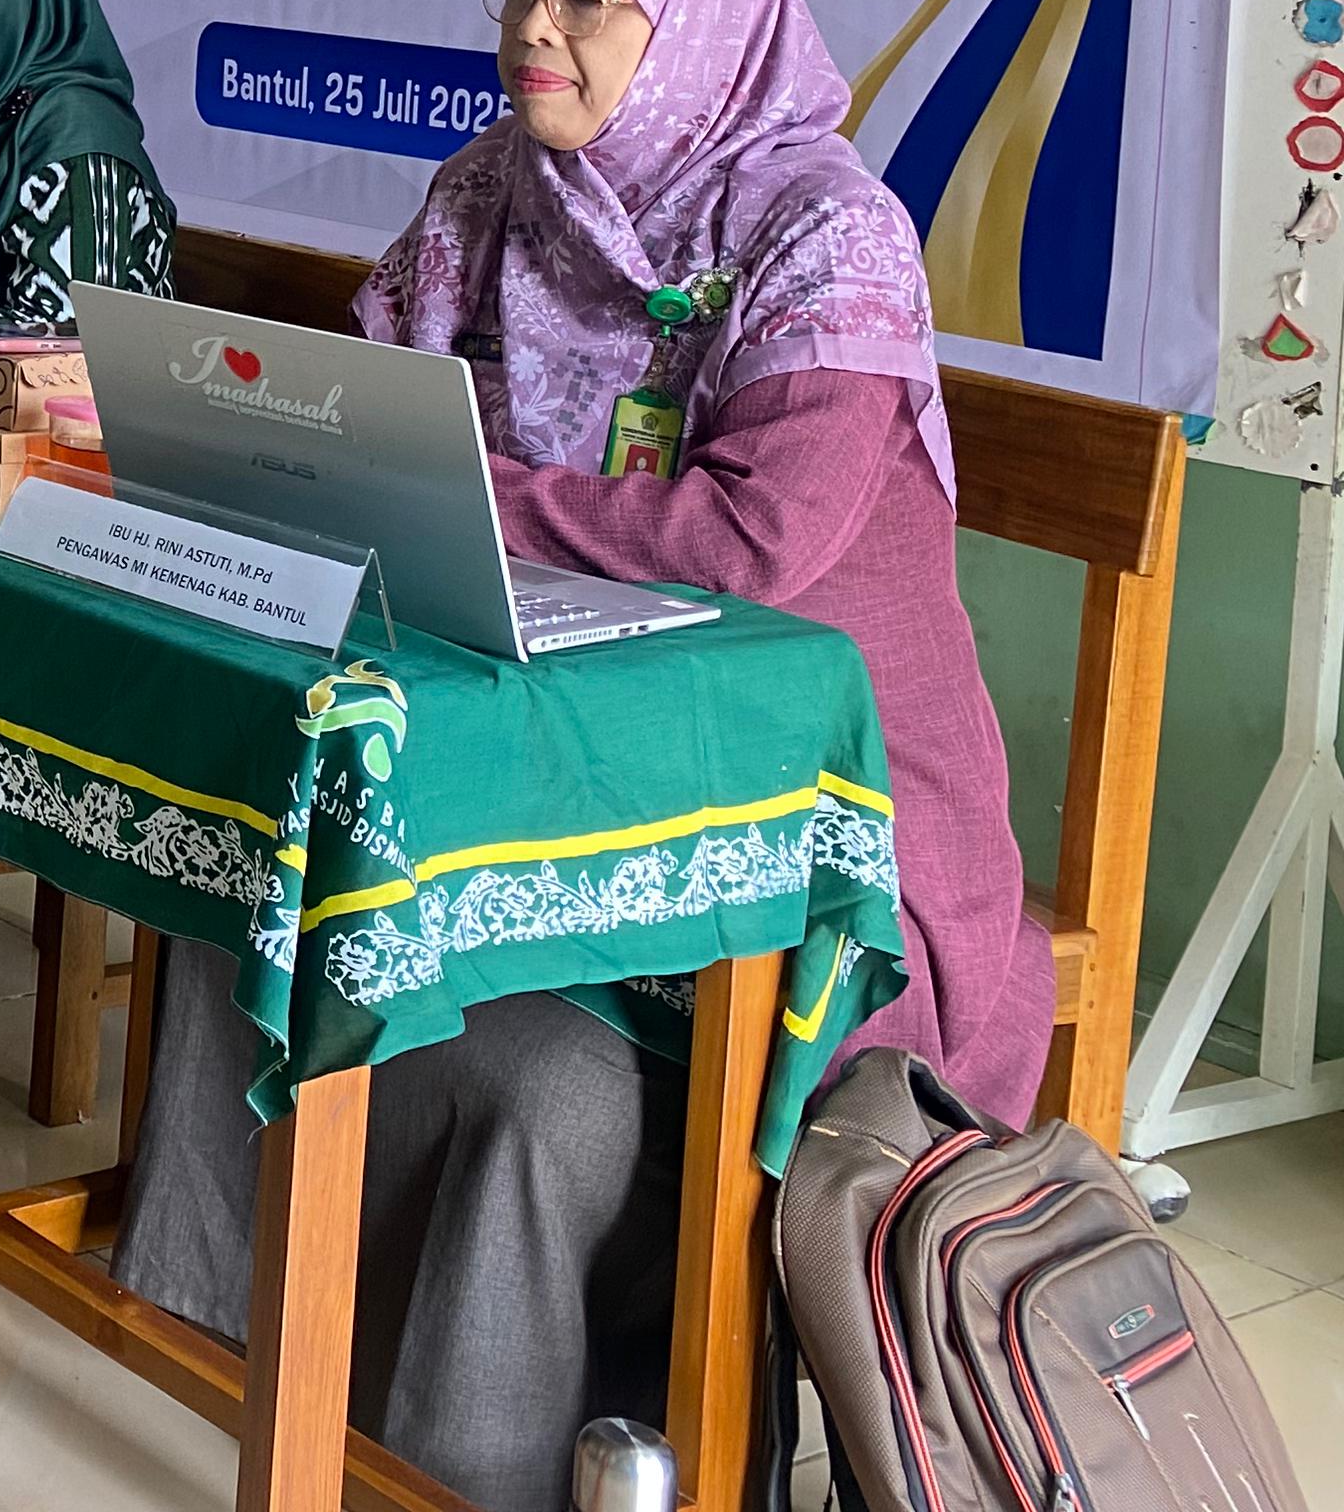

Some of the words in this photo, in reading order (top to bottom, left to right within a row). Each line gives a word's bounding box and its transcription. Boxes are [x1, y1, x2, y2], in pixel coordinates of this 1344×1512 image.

[222, 58, 315, 115] Bantul,
[324, 72, 364, 117] 25
[372, 78, 420, 126] Juli
[201, 378, 343, 424] madrasah
[55, 535, 130, 570] PENGAWAS
[130, 559, 149, 576] MI
[149, 563, 216, 597] KEMENAG
[217, 585, 250, 609] KAB.
[253, 597, 307, 627] BANTUL
[108, 523, 132, 541] IBU
[132, 530, 150, 548] HJ.
[154, 536, 184, 557] RINI
[184, 546, 233, 574] ASTUTI,
[236, 561, 274, 585] M.Pd
